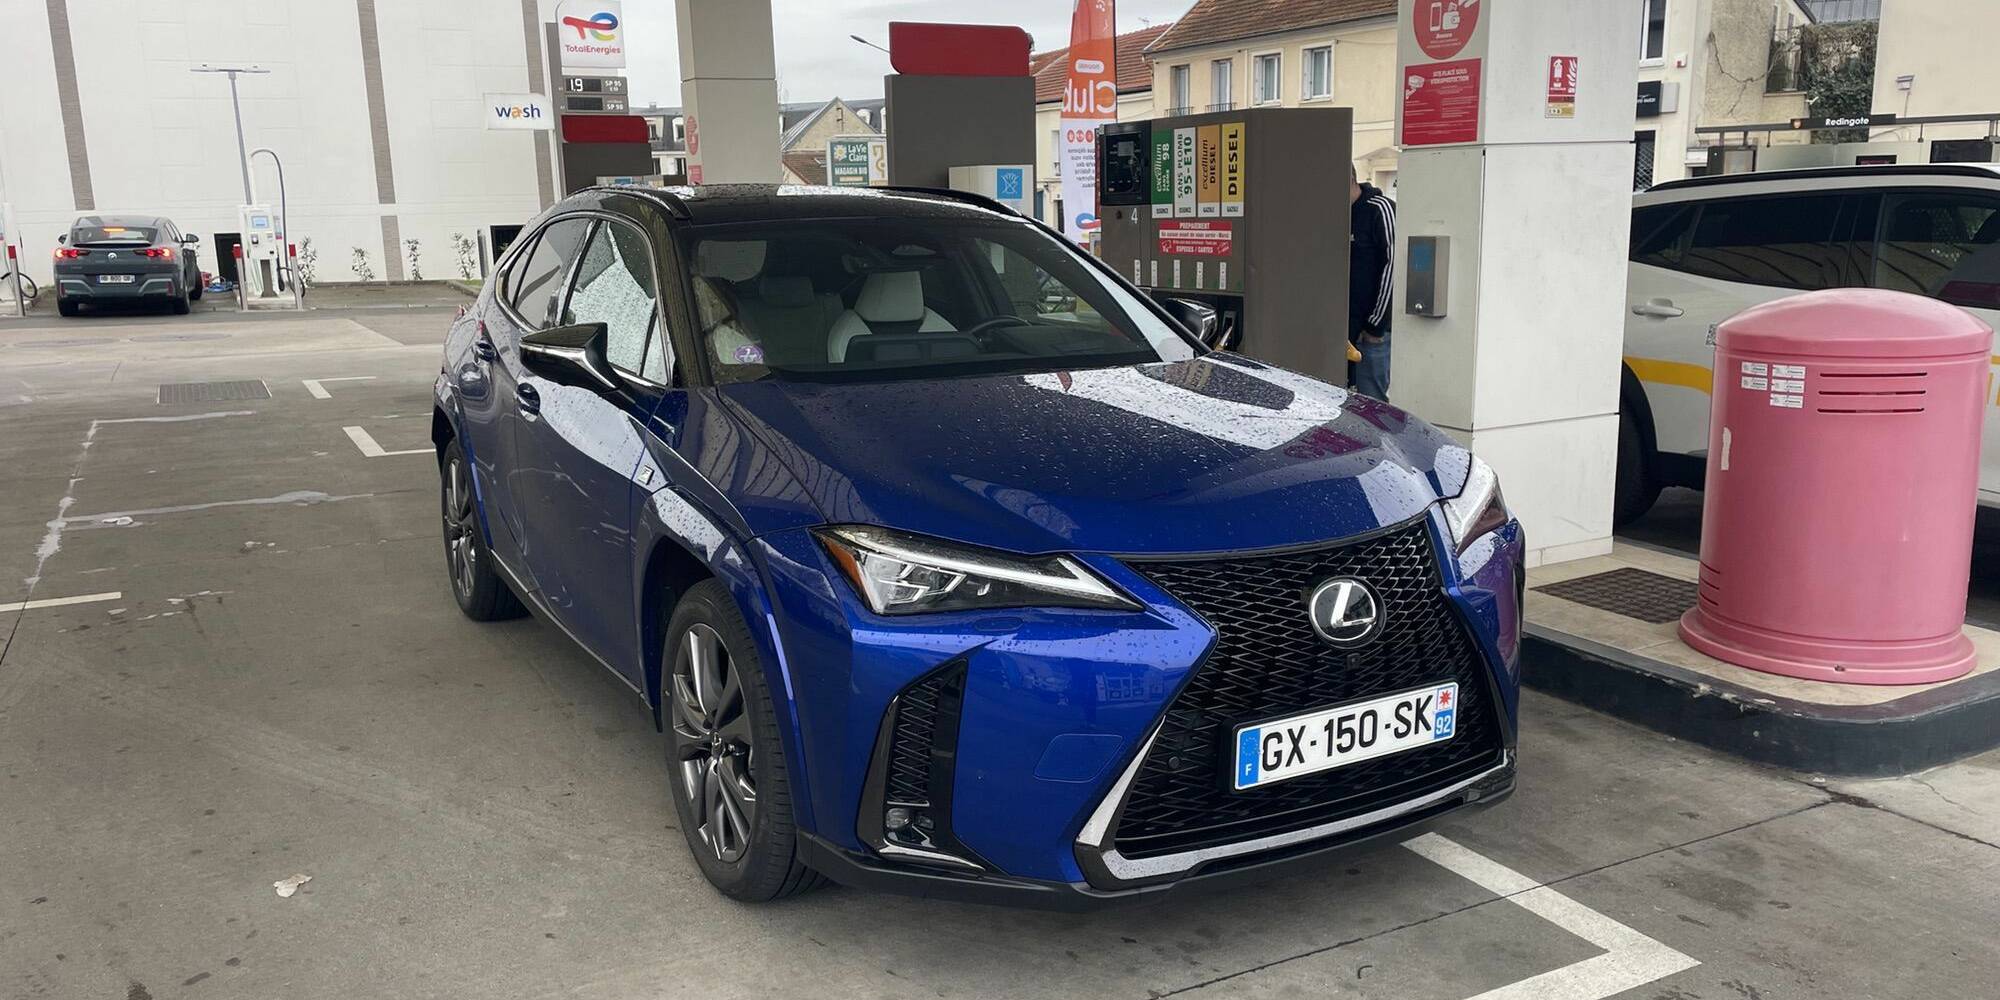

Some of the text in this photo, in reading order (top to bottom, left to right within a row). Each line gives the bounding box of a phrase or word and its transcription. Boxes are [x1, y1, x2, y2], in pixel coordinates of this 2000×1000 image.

[565, 44, 621, 55] TotalEnergies
[495, 104, 541, 118] wash
[1825, 117, 1869, 127] Redingote
[848, 152, 867, 162] Claire
[1162, 142, 1170, 161] 98
[1154, 144, 1162, 192] excellium
[1184, 136, 1192, 195] 95-E10
[1228, 129, 1238, 196] DIESEL
[1131, 207, 1138, 224] 4
[1261, 695, 1434, 772] GX-150-SK
[1436, 715, 1452, 735] 92
[1245, 763, 1252, 776] F
